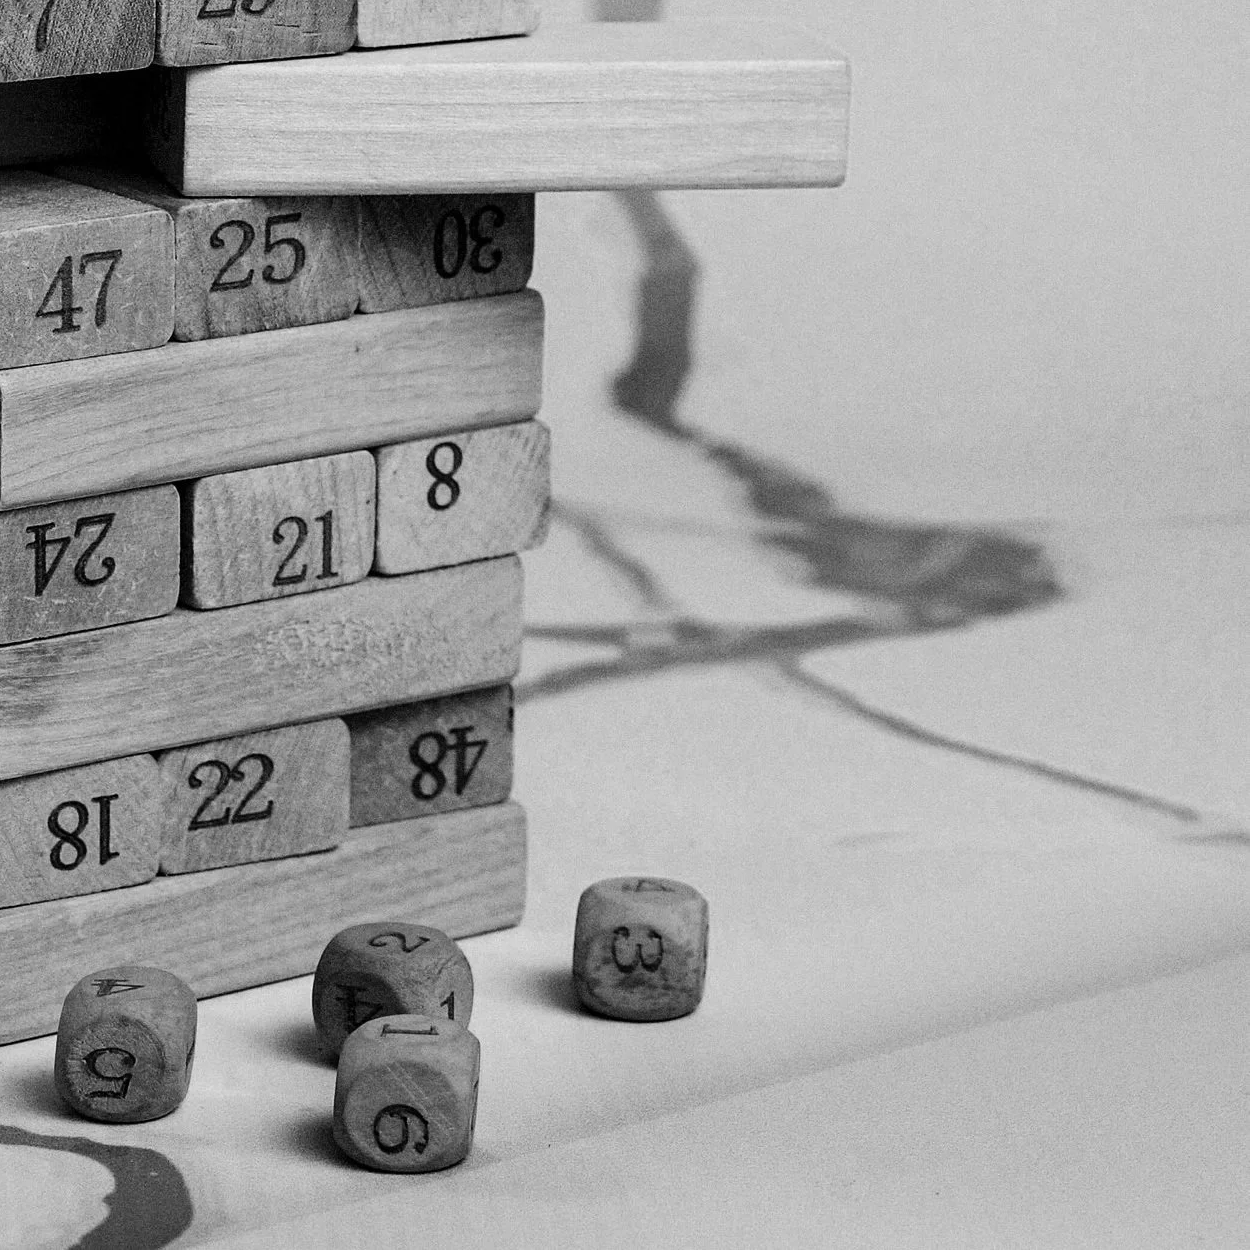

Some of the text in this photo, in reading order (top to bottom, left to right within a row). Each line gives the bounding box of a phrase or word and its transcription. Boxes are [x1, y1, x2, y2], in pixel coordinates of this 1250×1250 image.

[208, 211, 307, 293] 25
[433, 204, 507, 278] 30
[35, 249, 123, 335] 47
[426, 441, 464, 511] 8
[23, 512, 117, 597] 24
[271, 514, 339, 587] 21
[187, 752, 274, 830] 22
[409, 723, 487, 802] 48
[49, 792, 121, 871] 18
[369, 932, 430, 953] 2
[612, 926, 664, 973] 3
[83, 1048, 136, 1099] 5
[374, 1104, 429, 1154] 6
